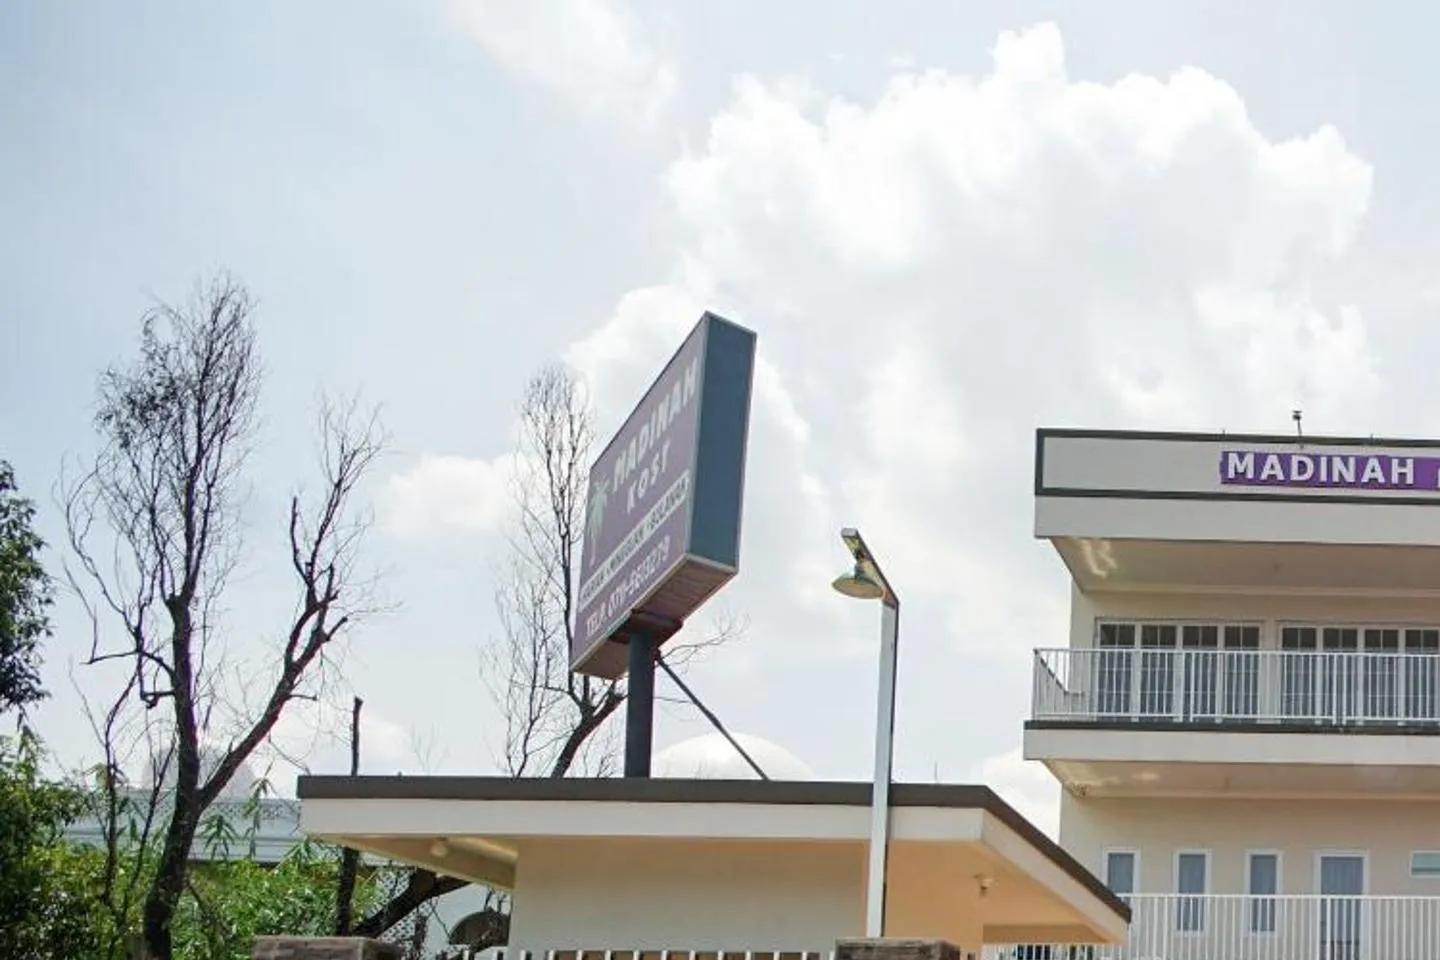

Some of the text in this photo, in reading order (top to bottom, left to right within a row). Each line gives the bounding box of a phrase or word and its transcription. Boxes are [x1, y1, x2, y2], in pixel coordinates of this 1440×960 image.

[613, 355, 698, 492] MADINAH
[626, 440, 671, 515] KOST
[1227, 452, 1415, 484] MADINAH
